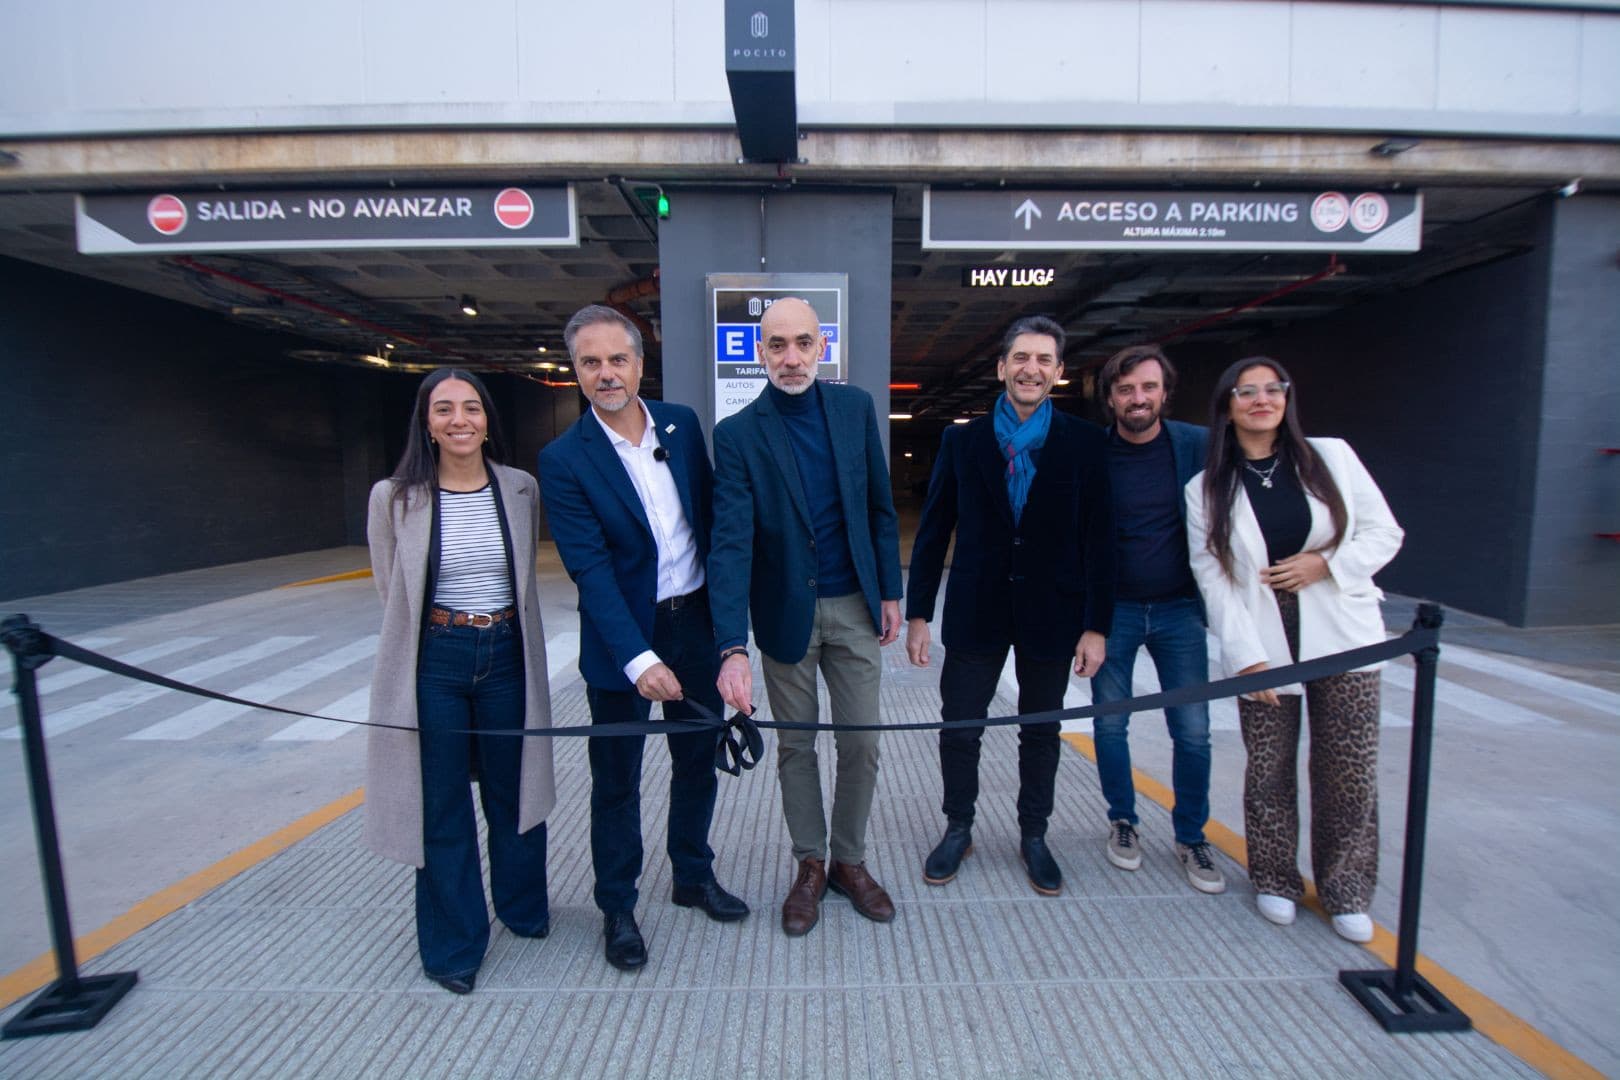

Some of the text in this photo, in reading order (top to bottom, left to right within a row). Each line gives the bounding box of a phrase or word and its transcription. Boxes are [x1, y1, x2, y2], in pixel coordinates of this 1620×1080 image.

[733, 48, 787, 57] POCITO
[197, 200, 286, 221] SALIDA
[308, 198, 346, 218] NO
[353, 197, 473, 218] AVANZAR
[1057, 202, 1157, 222] ACCESO
[1165, 202, 1182, 222] A
[1190, 203, 1298, 222] PARKING
[1361, 203, 1377, 217] 10
[1123, 227, 1160, 237] ALTURA
[971, 269, 1008, 286] HAY
[726, 331, 745, 356] E
